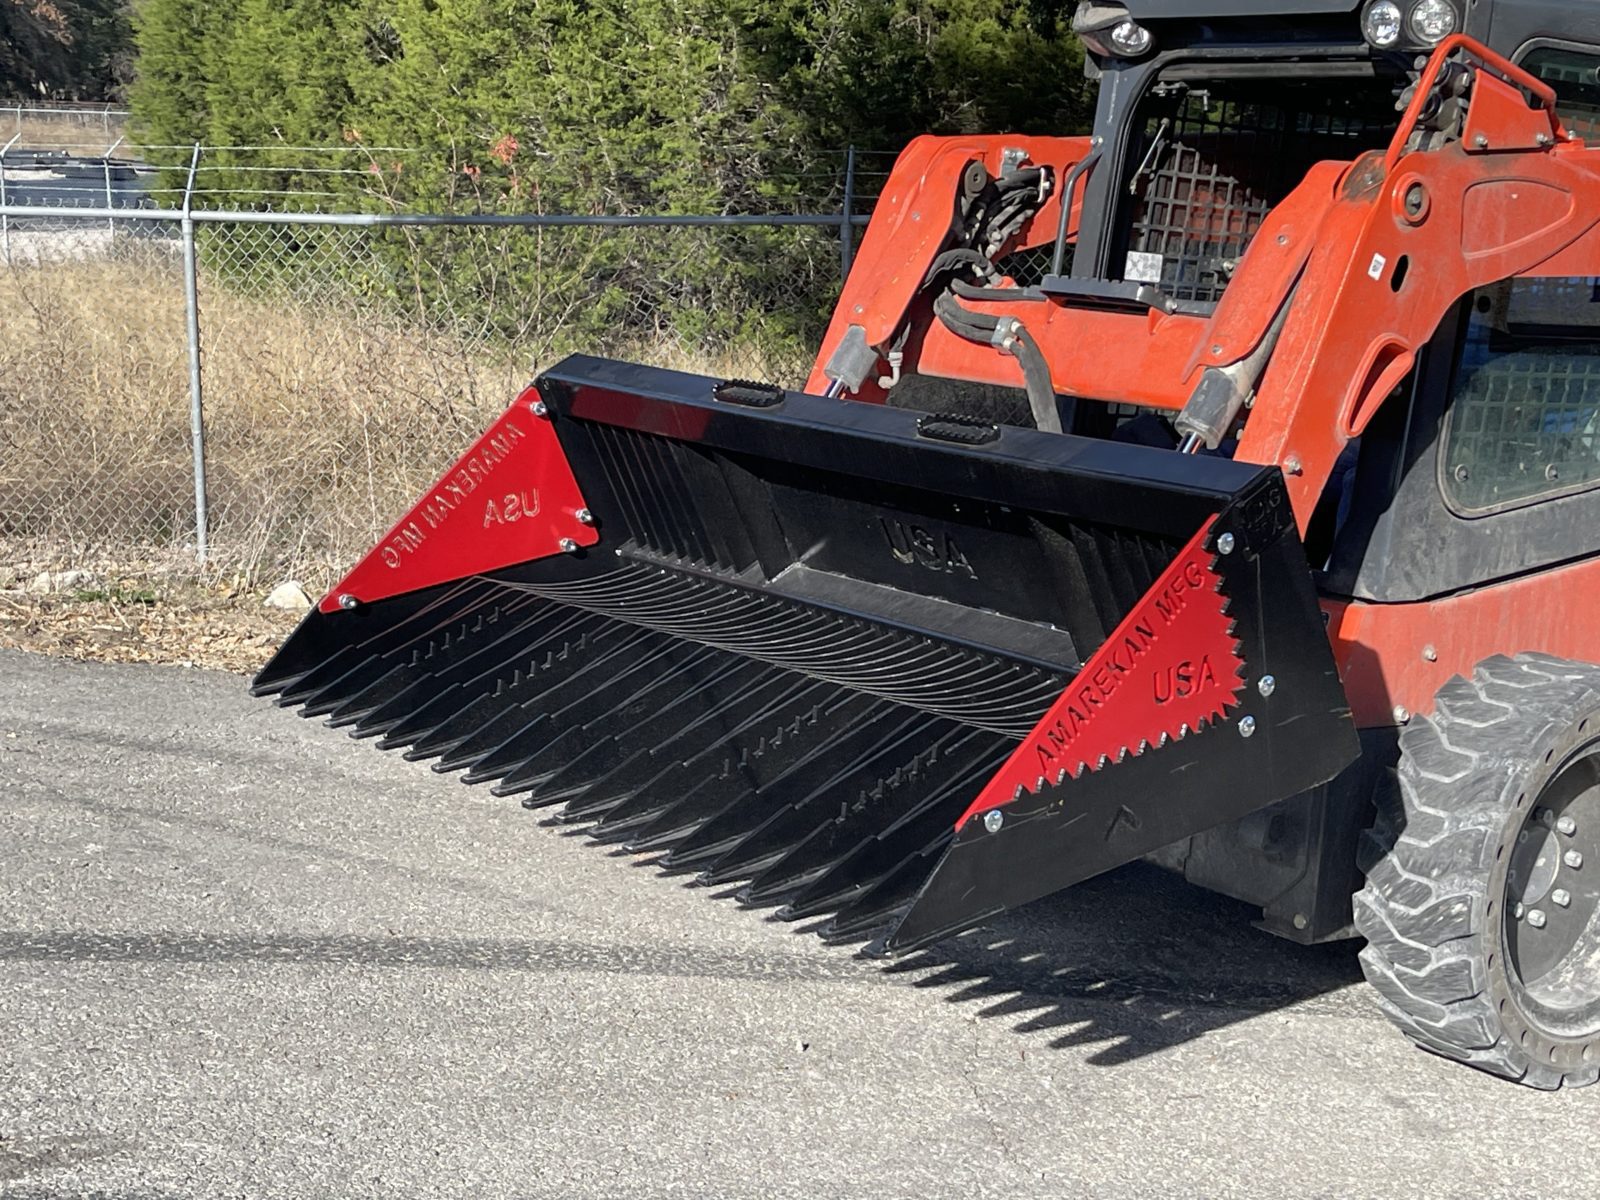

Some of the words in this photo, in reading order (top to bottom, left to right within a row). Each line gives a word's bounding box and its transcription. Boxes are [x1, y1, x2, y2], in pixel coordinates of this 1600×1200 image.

[877, 515, 979, 581] USA
[1035, 617, 1160, 774] AMAREKAN
[1155, 560, 1206, 625] MFG
[1152, 654, 1221, 706] USA
